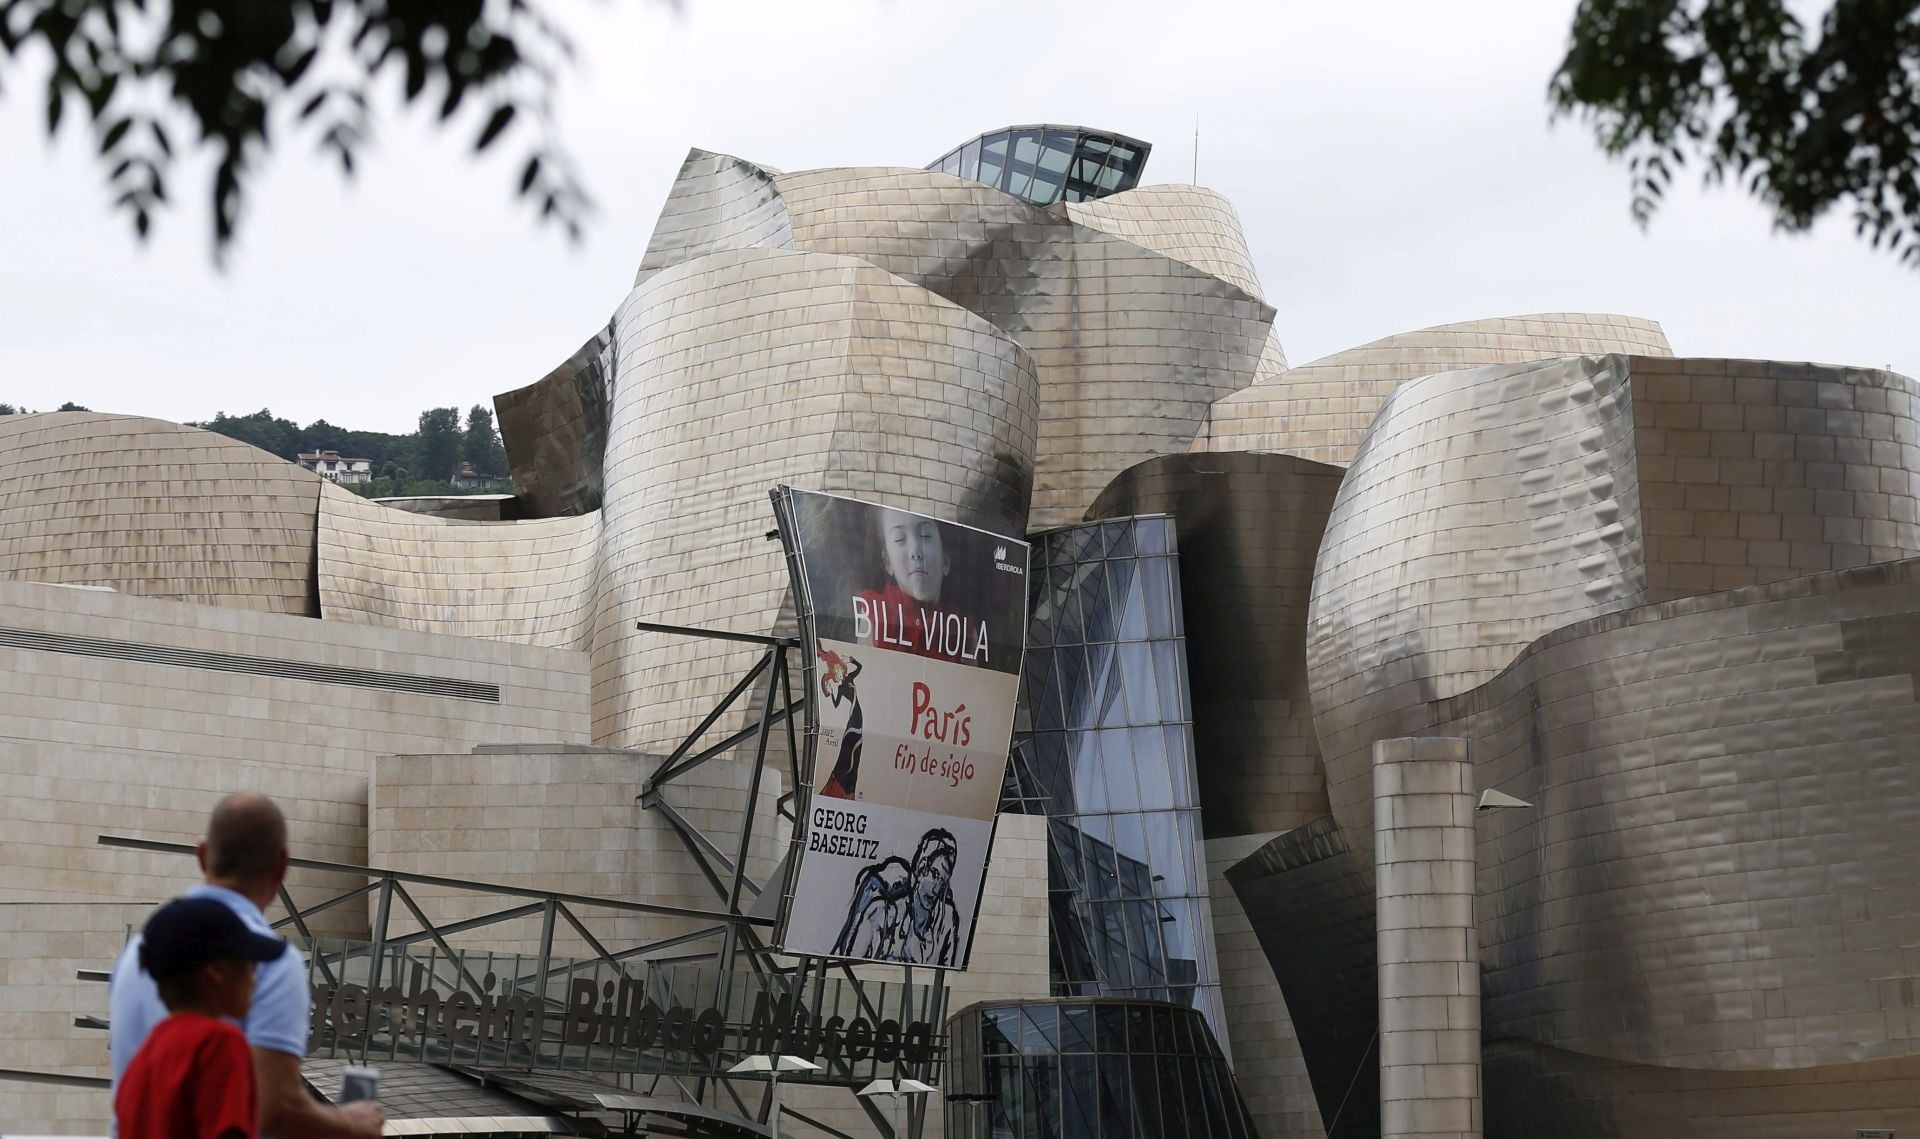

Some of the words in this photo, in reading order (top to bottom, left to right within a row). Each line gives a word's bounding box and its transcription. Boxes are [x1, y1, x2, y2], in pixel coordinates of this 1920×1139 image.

[852, 595, 913, 647] BILL
[920, 607, 989, 663] VIOLA
[910, 681, 971, 747] París
[895, 743, 916, 775] fin
[920, 746, 938, 776] de
[940, 753, 975, 787] siglo
[809, 831, 880, 860] BASELITZ
[813, 807, 868, 835] GEORG
[565, 977, 725, 1053] Bilbao
